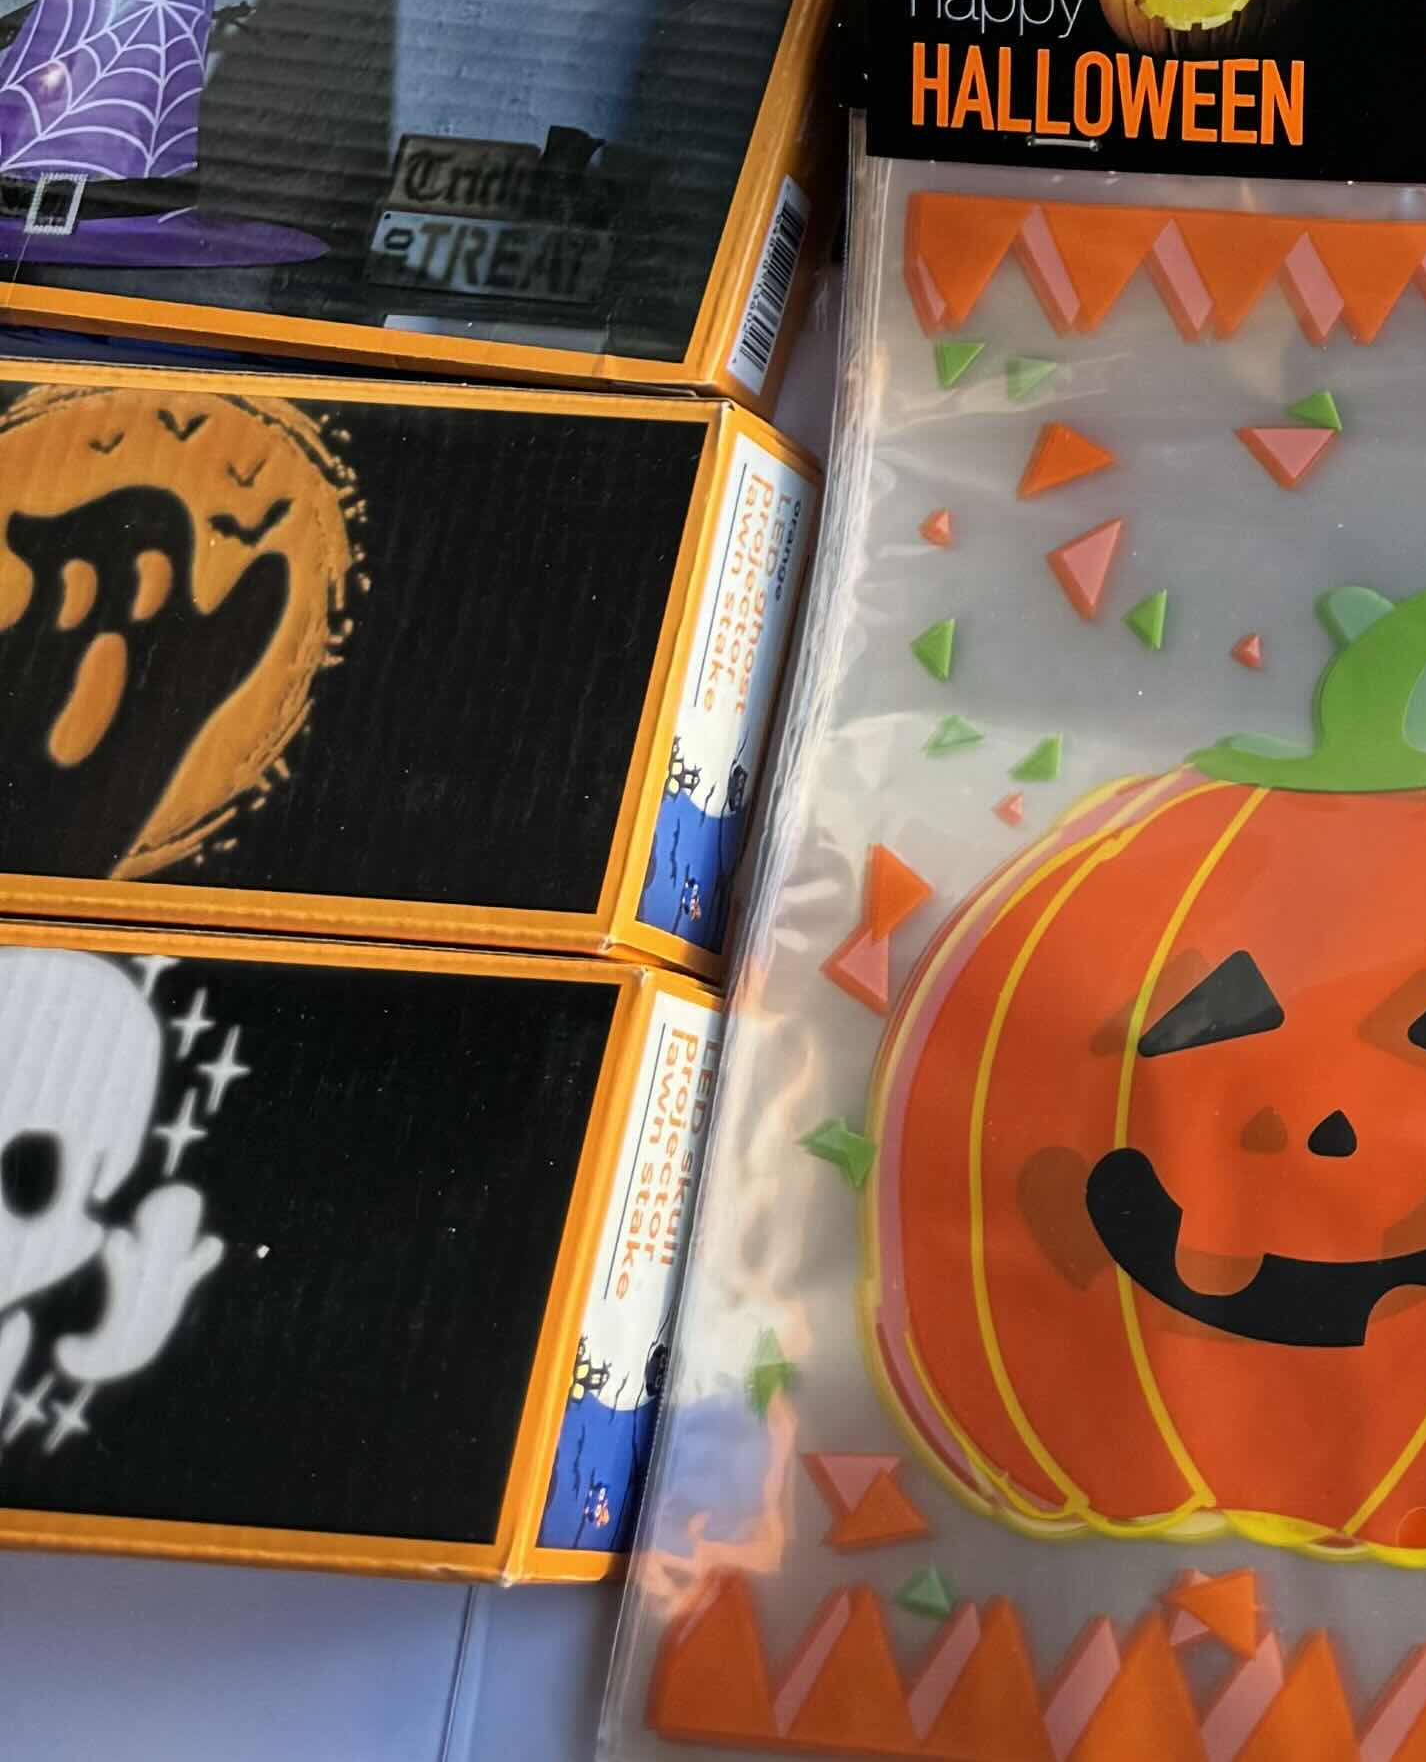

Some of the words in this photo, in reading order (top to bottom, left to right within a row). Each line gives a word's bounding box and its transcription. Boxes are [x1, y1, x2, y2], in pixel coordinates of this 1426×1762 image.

[911, 42, 1305, 146] HALLOWEEN
[728, 475, 774, 683] projector
[731, 473, 764, 576] lawn
[766, 492, 792, 578] LED
[776, 500, 801, 602] orange
[704, 590, 735, 713] stake
[736, 588, 766, 715] ghost
[649, 1028, 686, 1144] lawn
[691, 1039, 720, 1135] LED
[644, 1032, 699, 1263] projector
[616, 1162, 653, 1300] stake
[660, 1149, 693, 1267] skull
